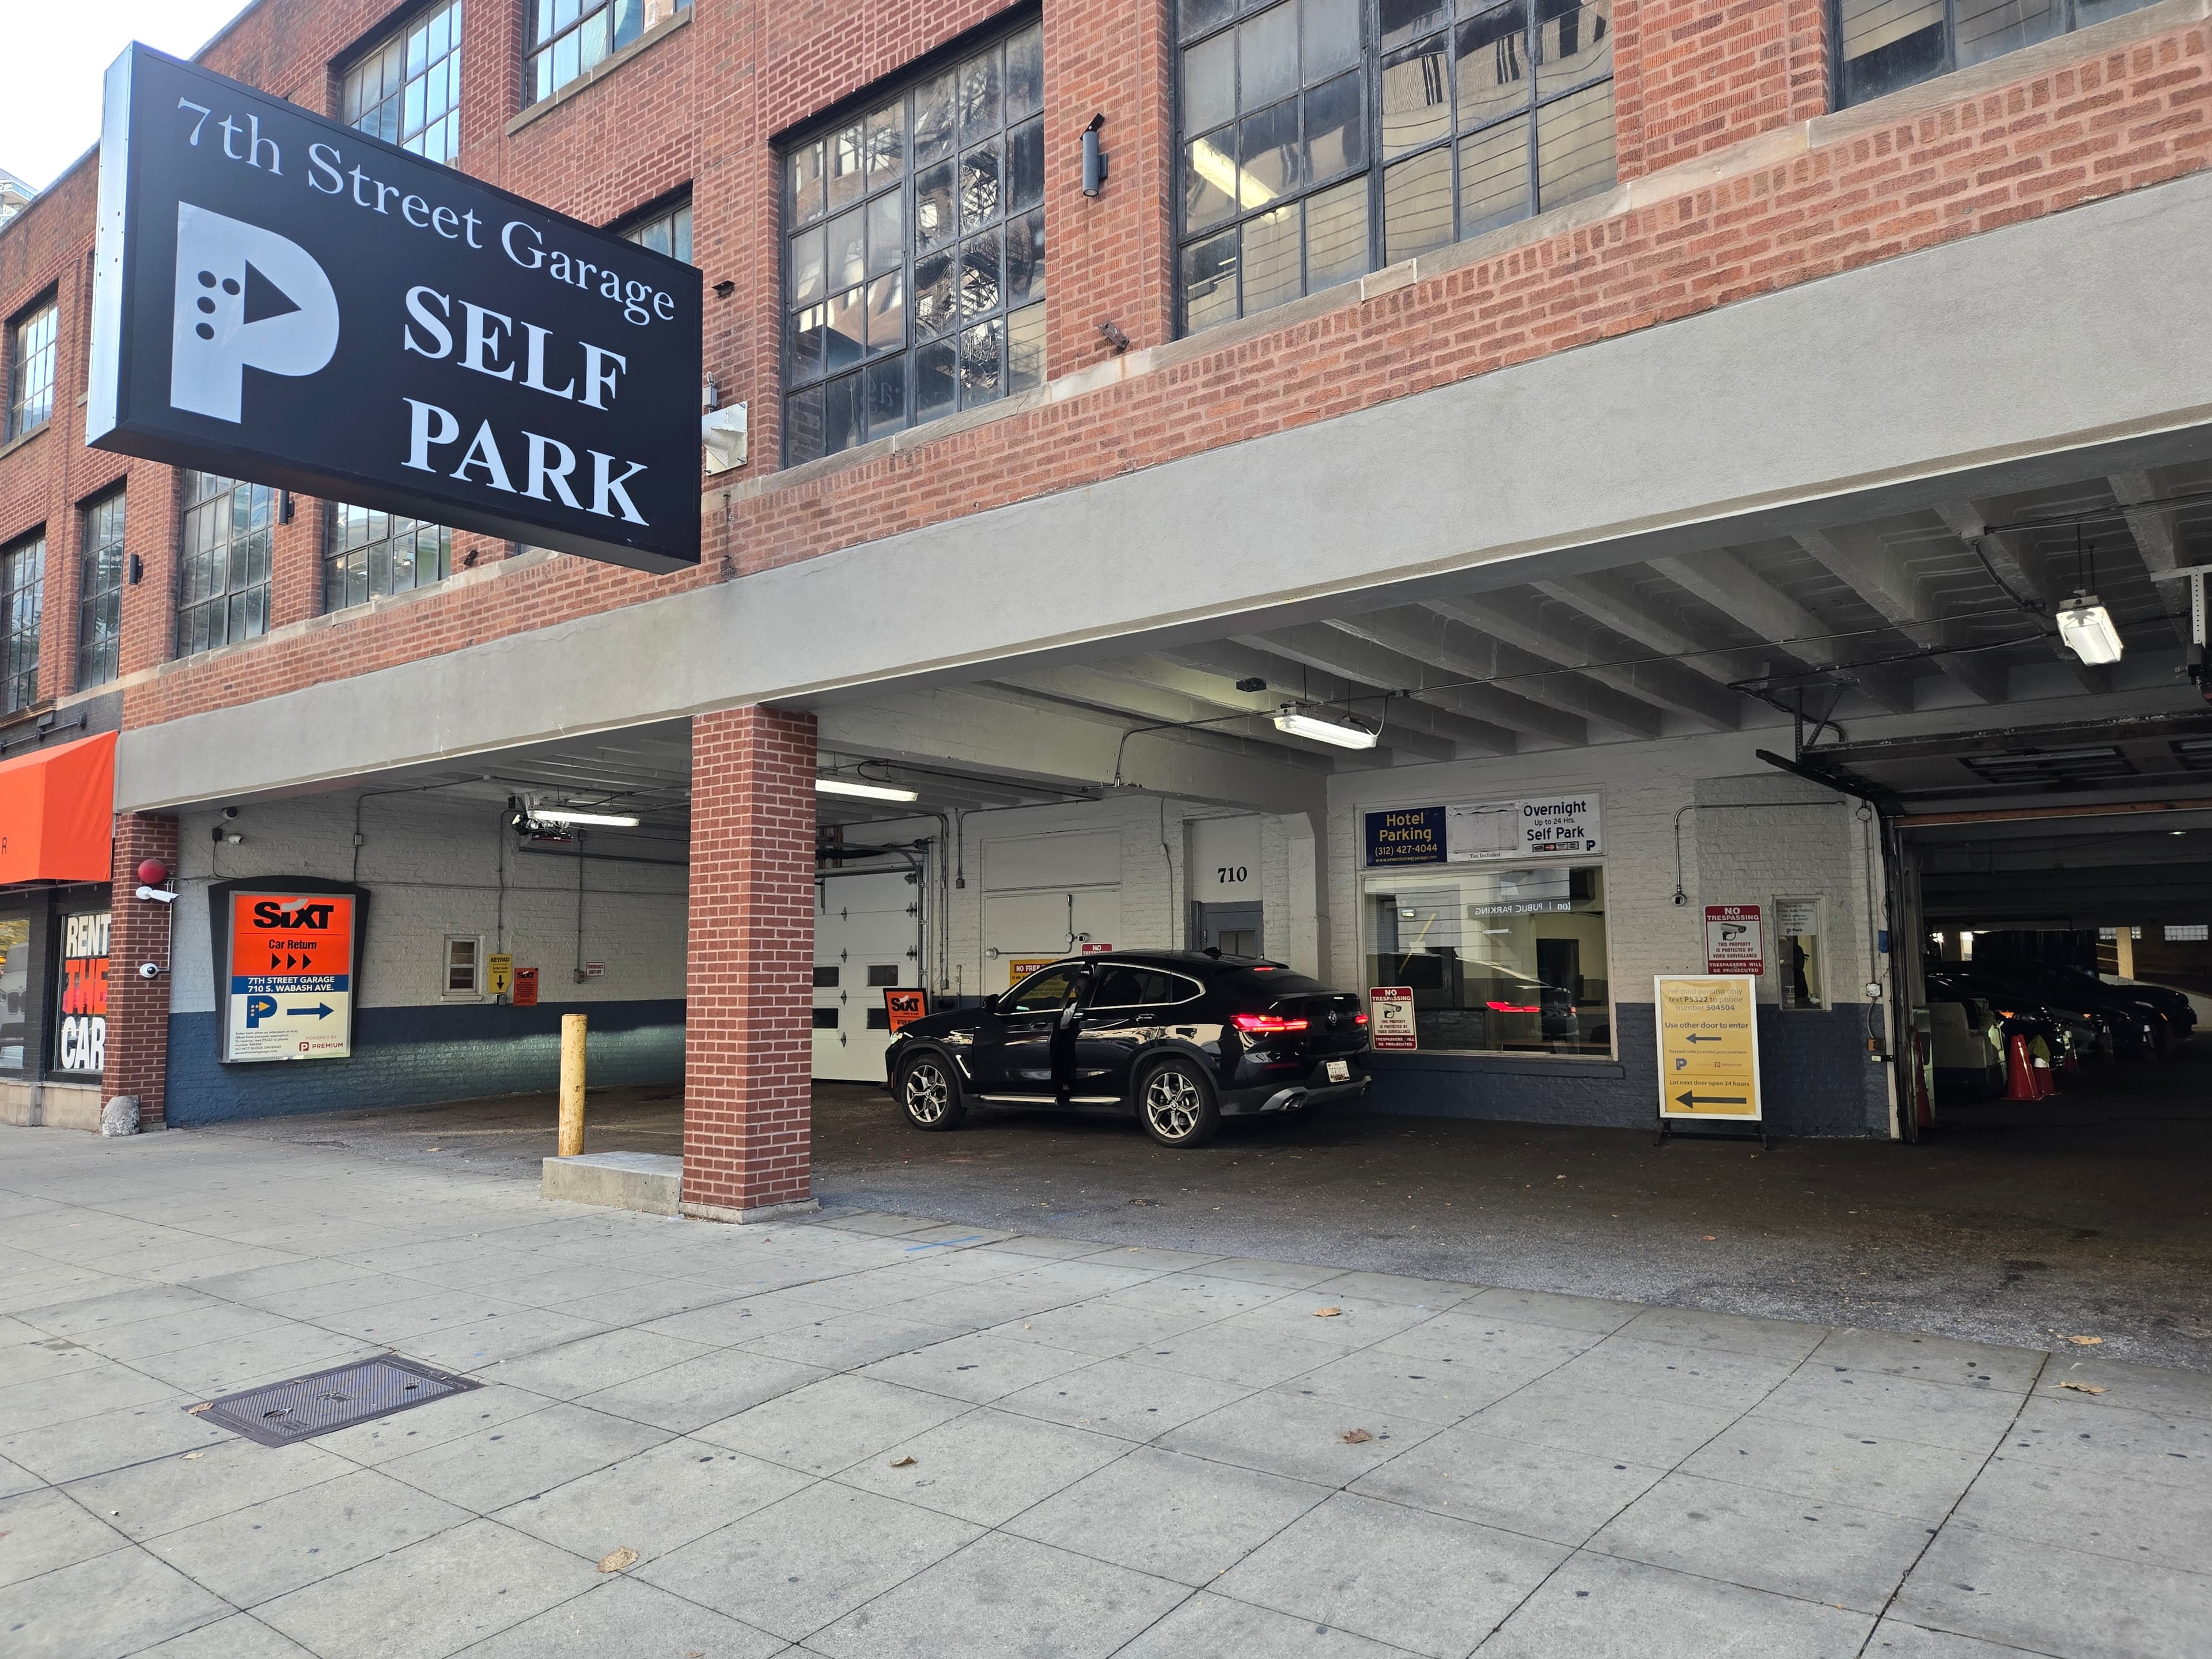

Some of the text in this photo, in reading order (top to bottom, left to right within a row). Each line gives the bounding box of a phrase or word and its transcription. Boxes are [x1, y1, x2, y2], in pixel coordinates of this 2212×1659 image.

[177, 96, 676, 327] 7th Street Garage
[404, 285, 627, 412] SELF
[400, 396, 651, 527] PARK
[1524, 801, 1586, 817] Overnight
[1387, 812, 1424, 827] Hotel
[1380, 827, 1431, 842] Parking
[1527, 826, 1585, 841] Self Park
[1375, 843, 1438, 857] (312) 427-4044
[1218, 866, 1247, 883] 710
[66, 914, 111, 957] RENT
[269, 940, 317, 949] Car Return
[65, 959, 109, 1014] THE
[61, 1016, 106, 1070] CAR
